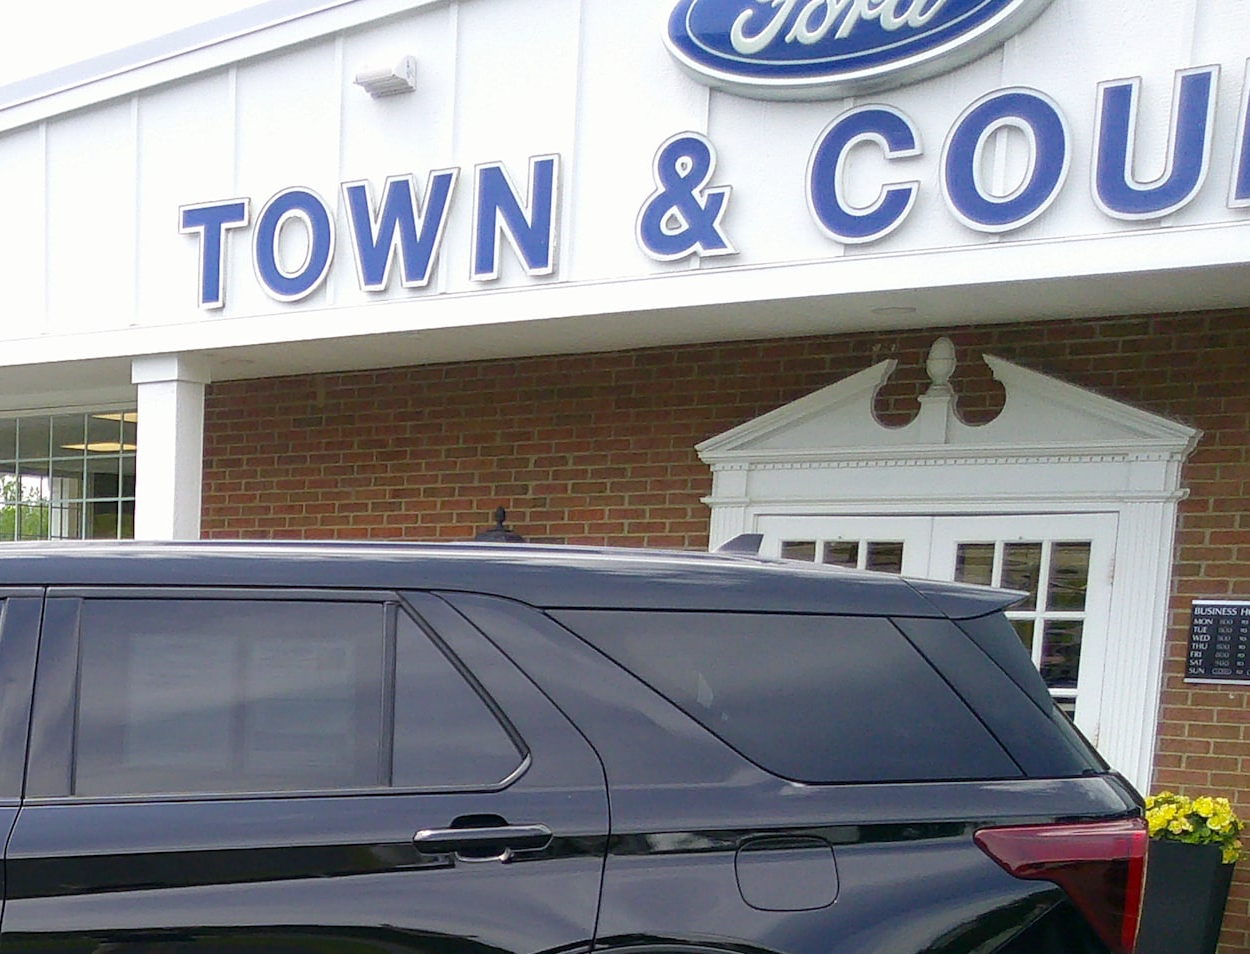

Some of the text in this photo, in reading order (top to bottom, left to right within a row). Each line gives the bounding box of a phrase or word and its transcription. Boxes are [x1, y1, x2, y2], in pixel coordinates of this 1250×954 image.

[178, 57, 1250, 310] TOWN & COU
[1194, 607, 1238, 616] BUSINESS
[1192, 634, 1211, 642] WED
